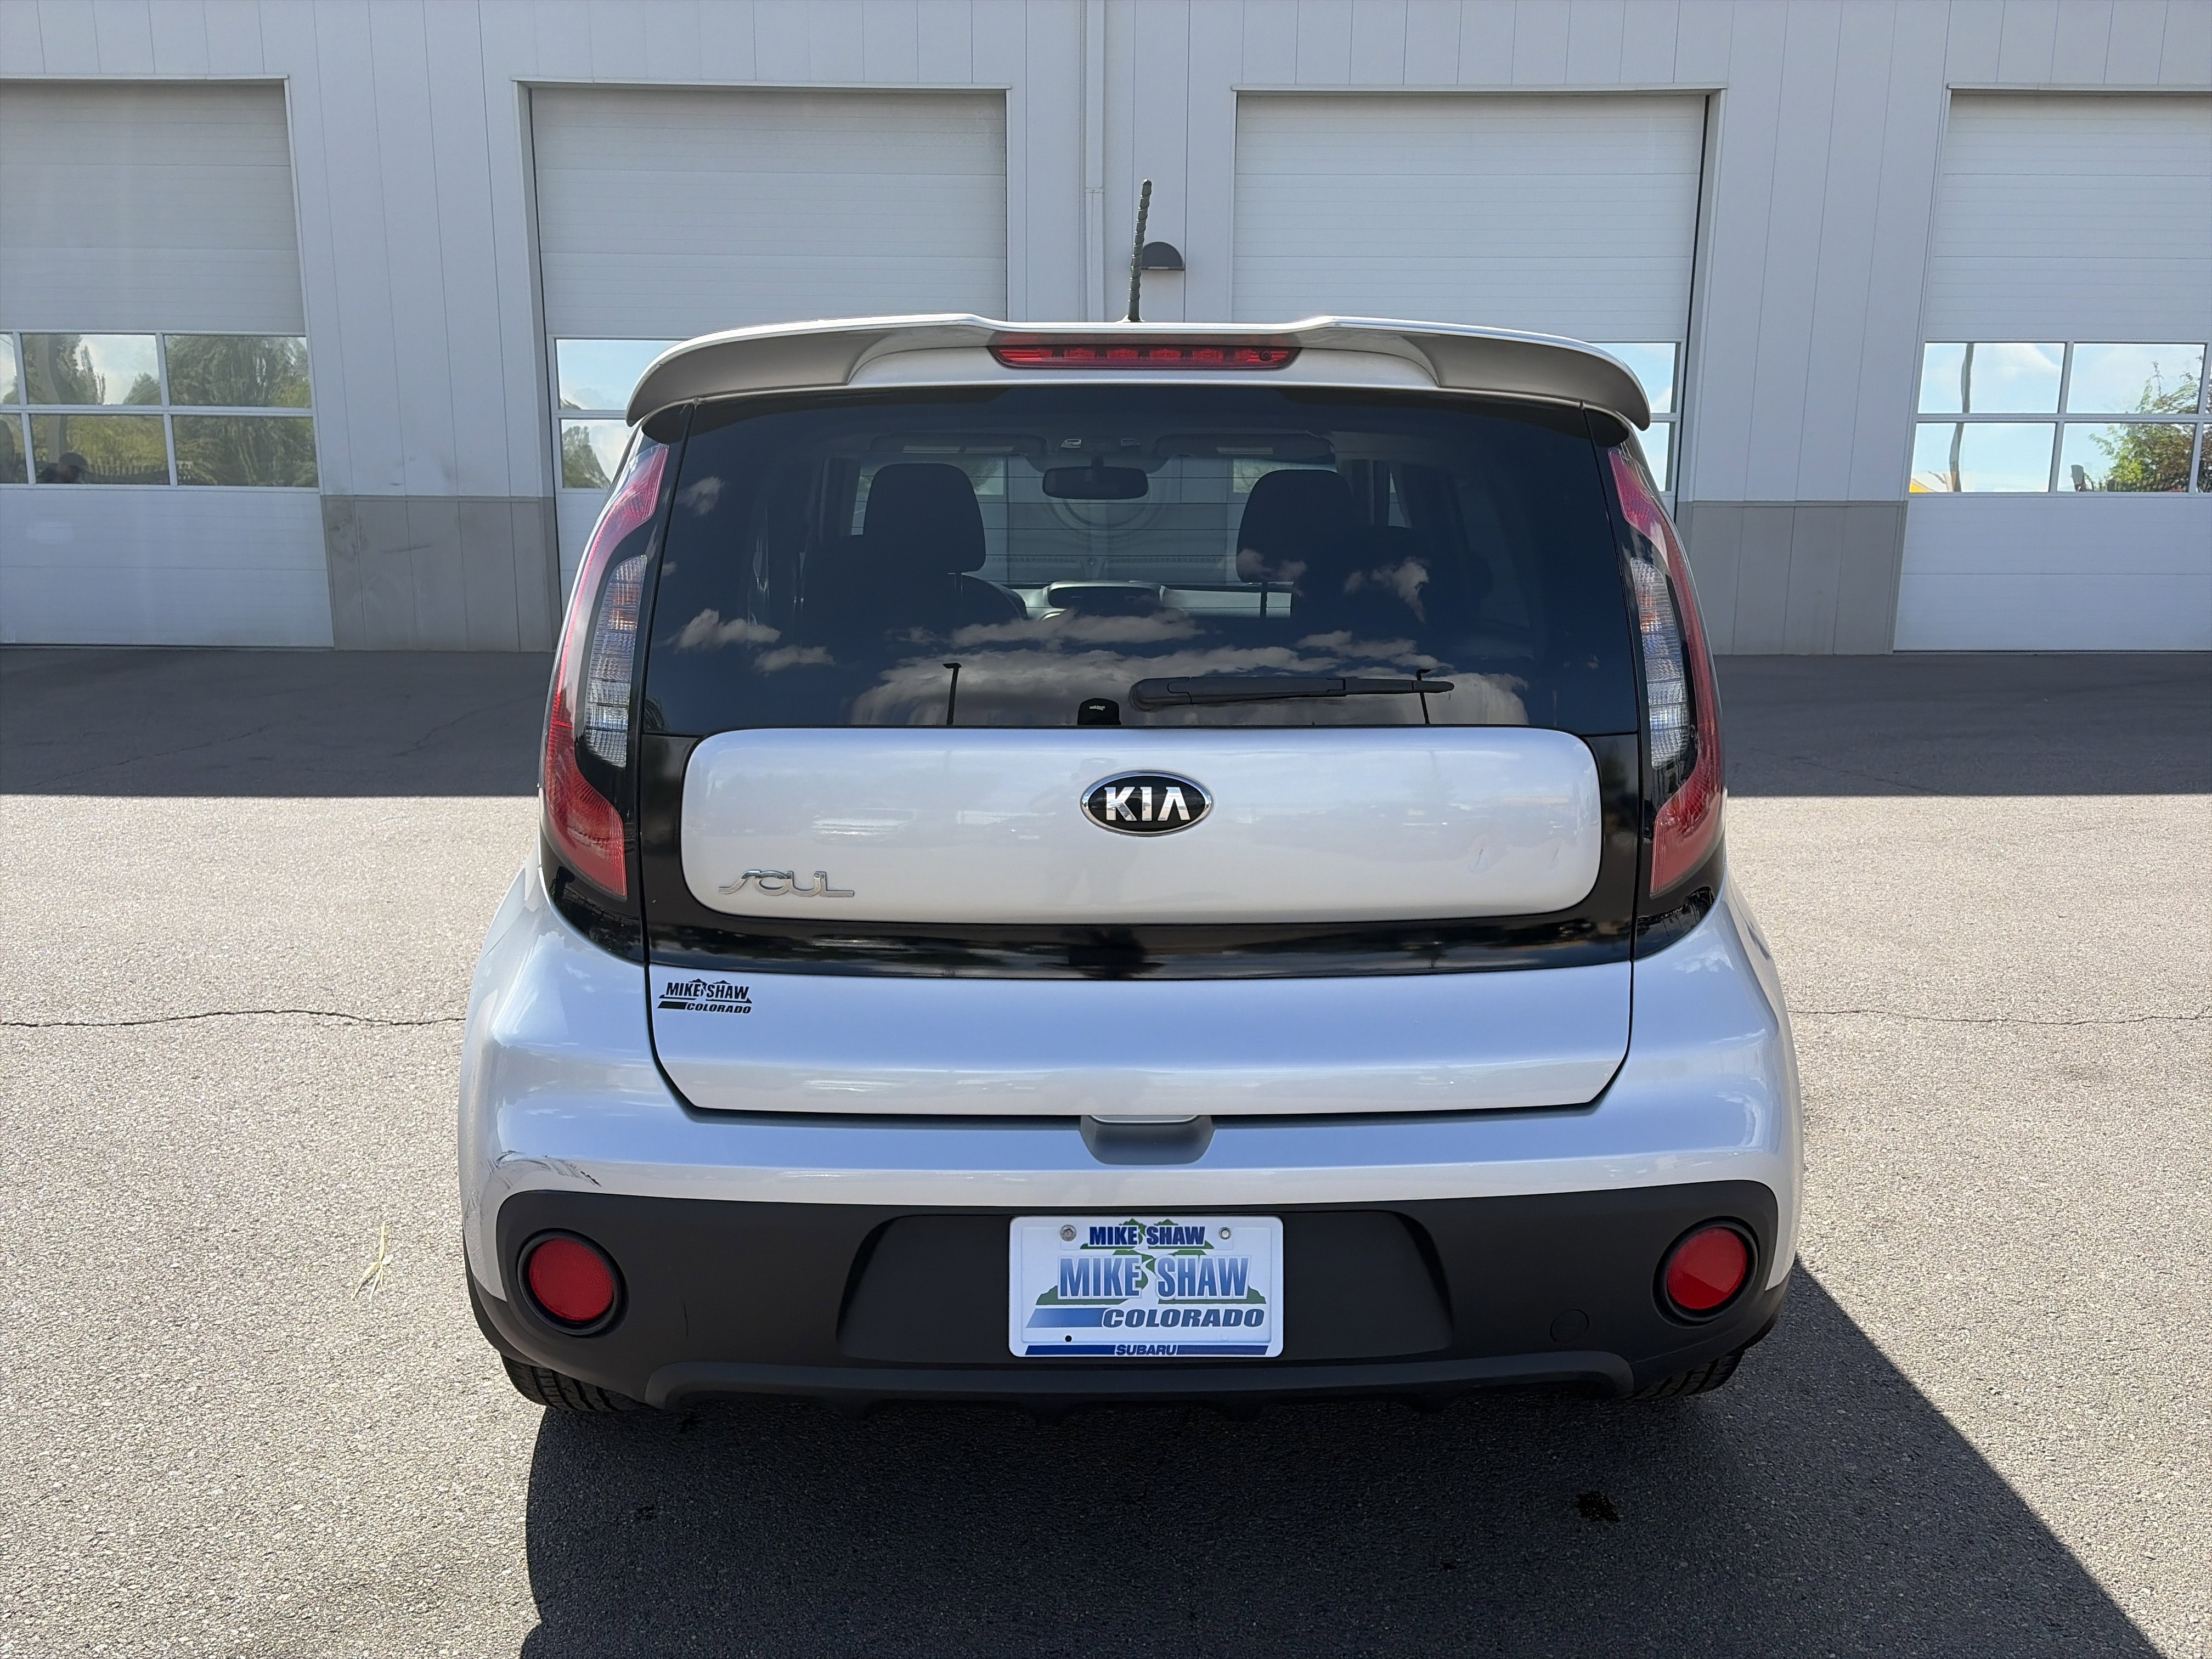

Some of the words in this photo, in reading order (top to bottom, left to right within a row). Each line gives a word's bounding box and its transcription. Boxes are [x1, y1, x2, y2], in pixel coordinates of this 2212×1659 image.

[1104, 786, 1191, 821] KIA
[718, 869, 855, 897] SOUL
[665, 982, 702, 997] MIKE
[706, 984, 750, 1000] SHAW
[686, 1002, 752, 1014] COLORADO
[1089, 1226, 1138, 1245] MIKE
[1146, 1226, 1206, 1245] SHAW
[1059, 1257, 1141, 1297] MIKE
[1157, 1256, 1250, 1298] SHAW
[1102, 1308, 1265, 1328] COLORADO
[1115, 1344, 1177, 1356] SUBARU
